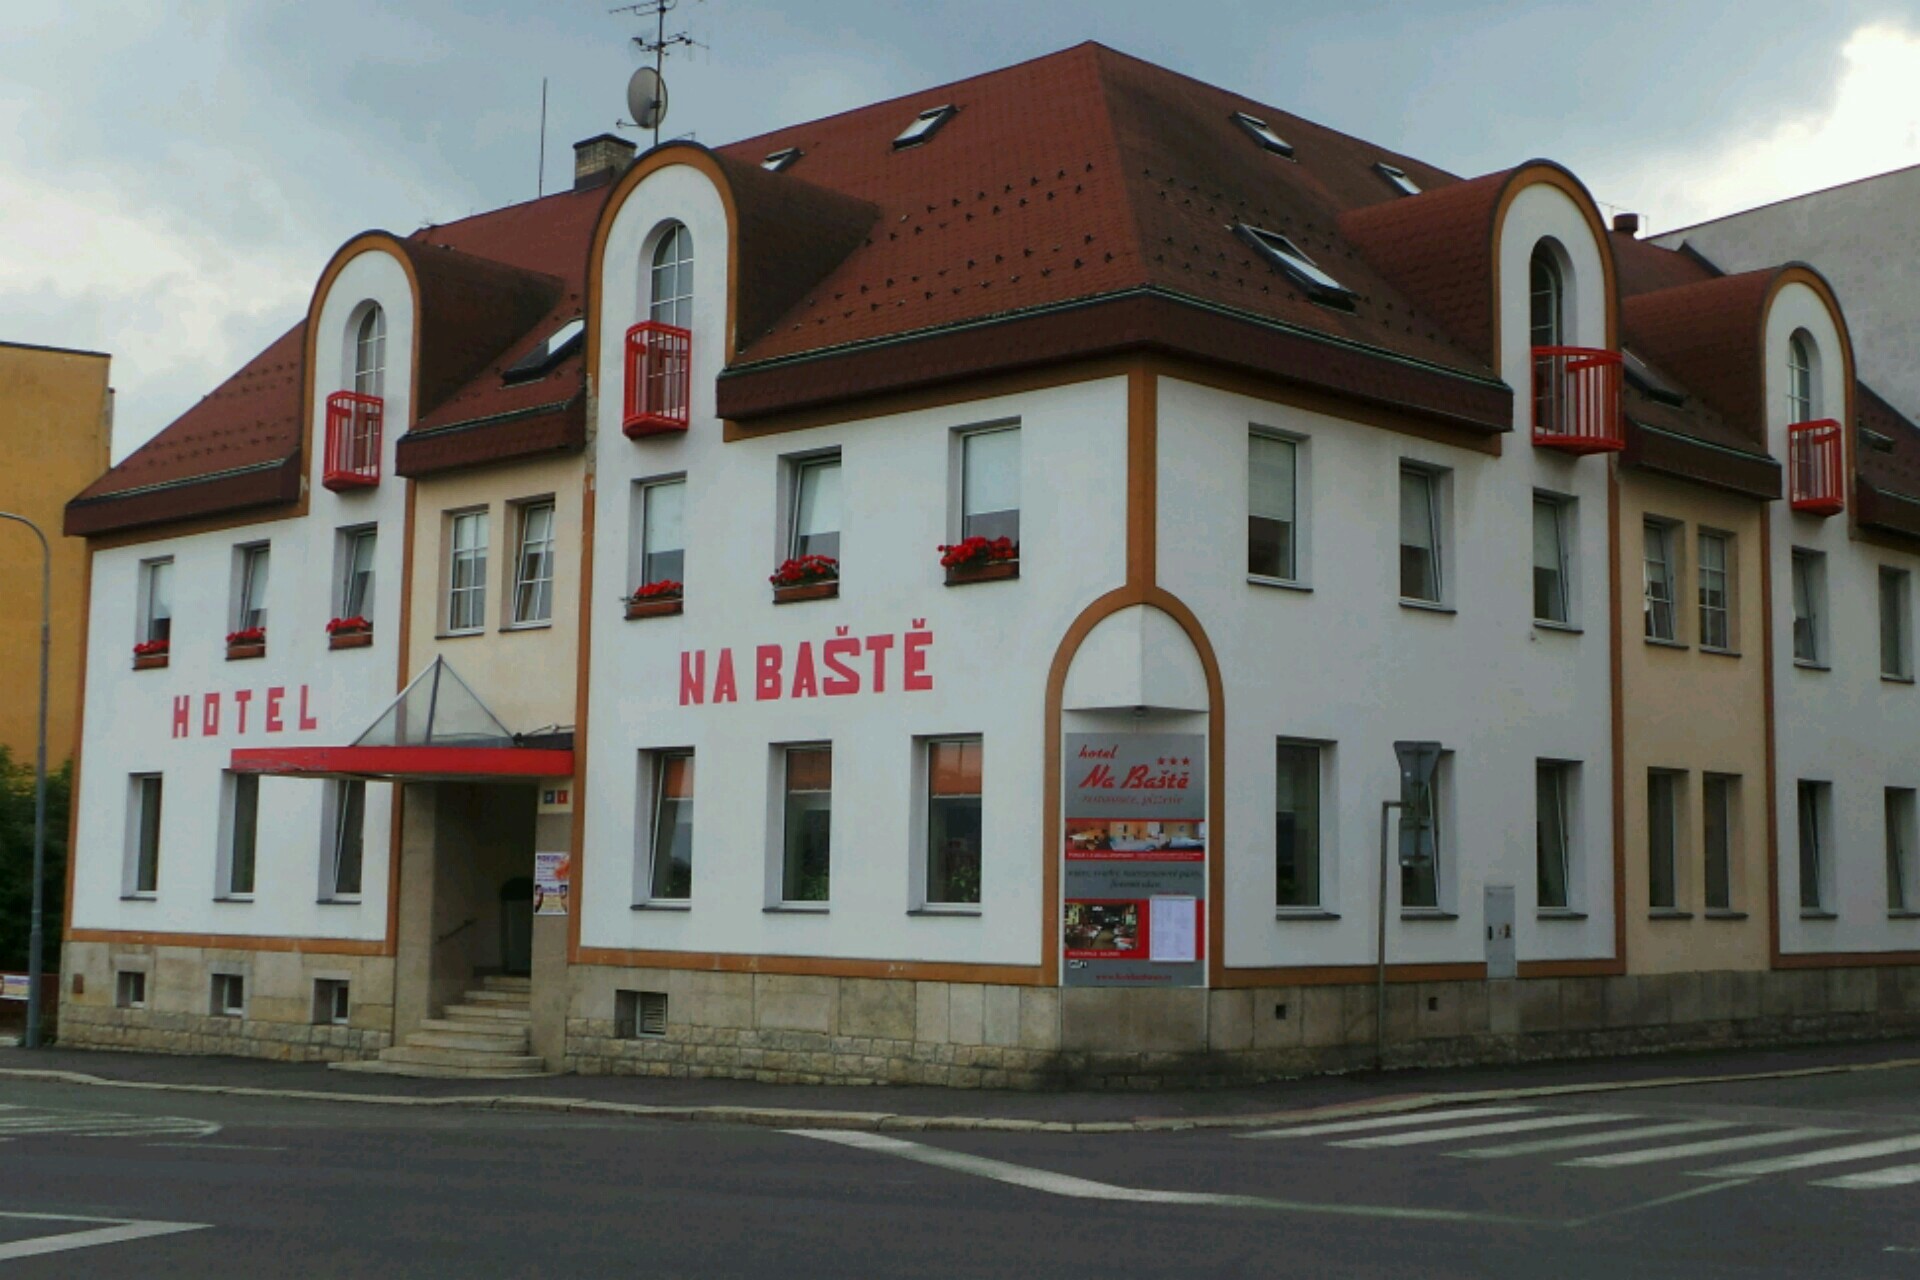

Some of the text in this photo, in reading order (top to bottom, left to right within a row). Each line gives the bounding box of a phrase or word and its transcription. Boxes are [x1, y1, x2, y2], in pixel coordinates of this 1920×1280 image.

[679, 618, 933, 706] NA BAŠTĚ
[172, 684, 317, 739] HOTEL
[1078, 744, 1119, 759] hotel
[1079, 763, 1190, 789] Na Baště
